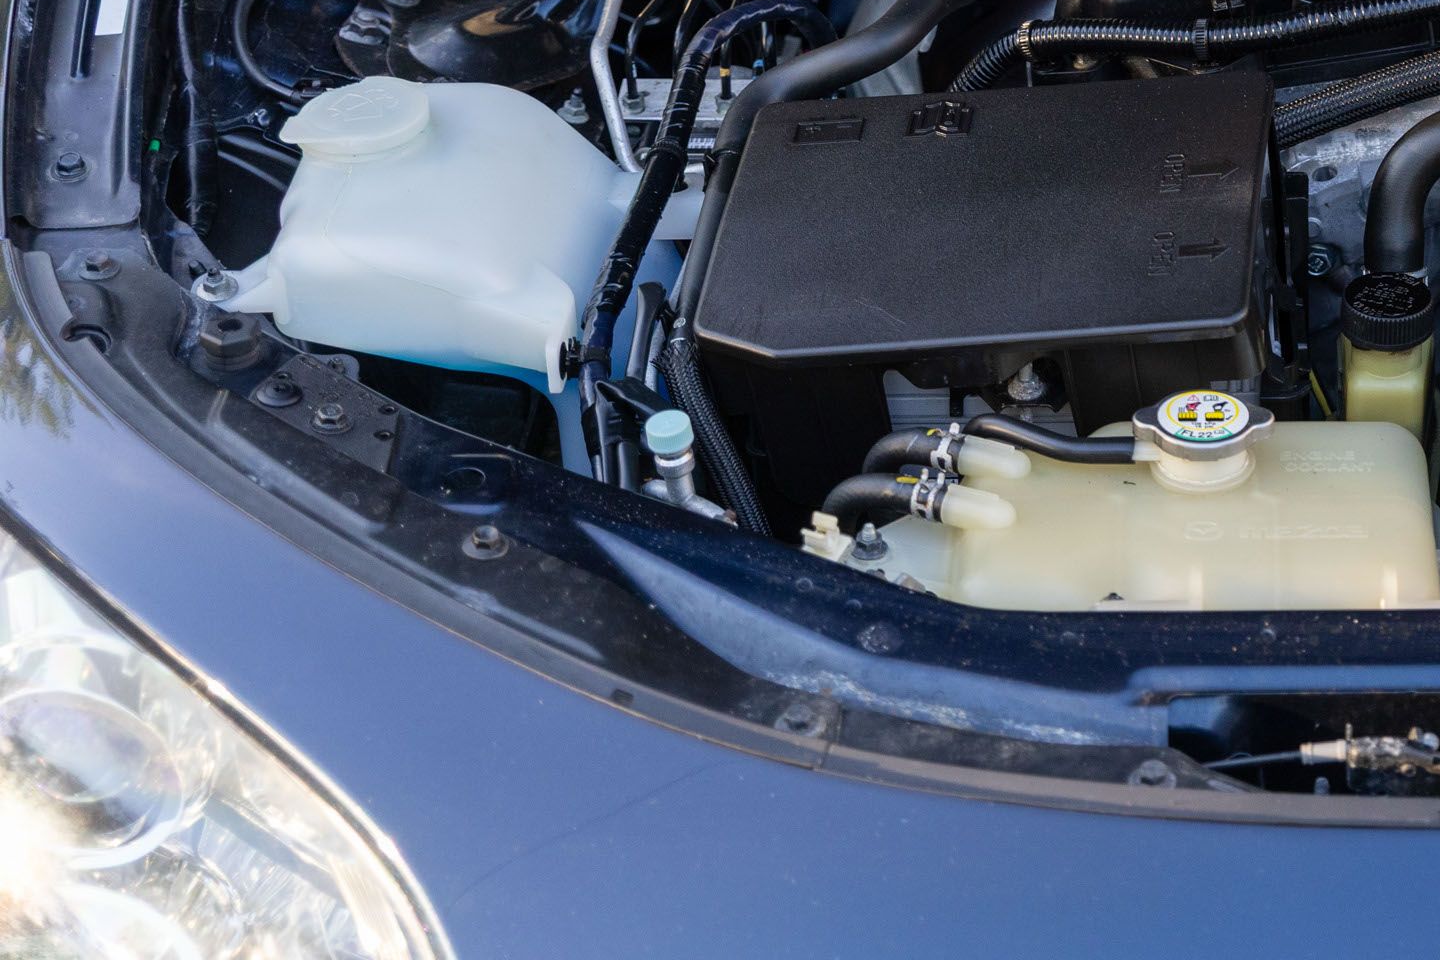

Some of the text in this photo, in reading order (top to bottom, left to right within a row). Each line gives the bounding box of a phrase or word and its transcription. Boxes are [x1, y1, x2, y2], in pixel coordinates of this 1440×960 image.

[1159, 153, 1185, 193] OPEN
[1181, 429, 1213, 438] FL22
[1280, 450, 1356, 462] ENGINE
[1284, 462, 1376, 473] COOLANT
